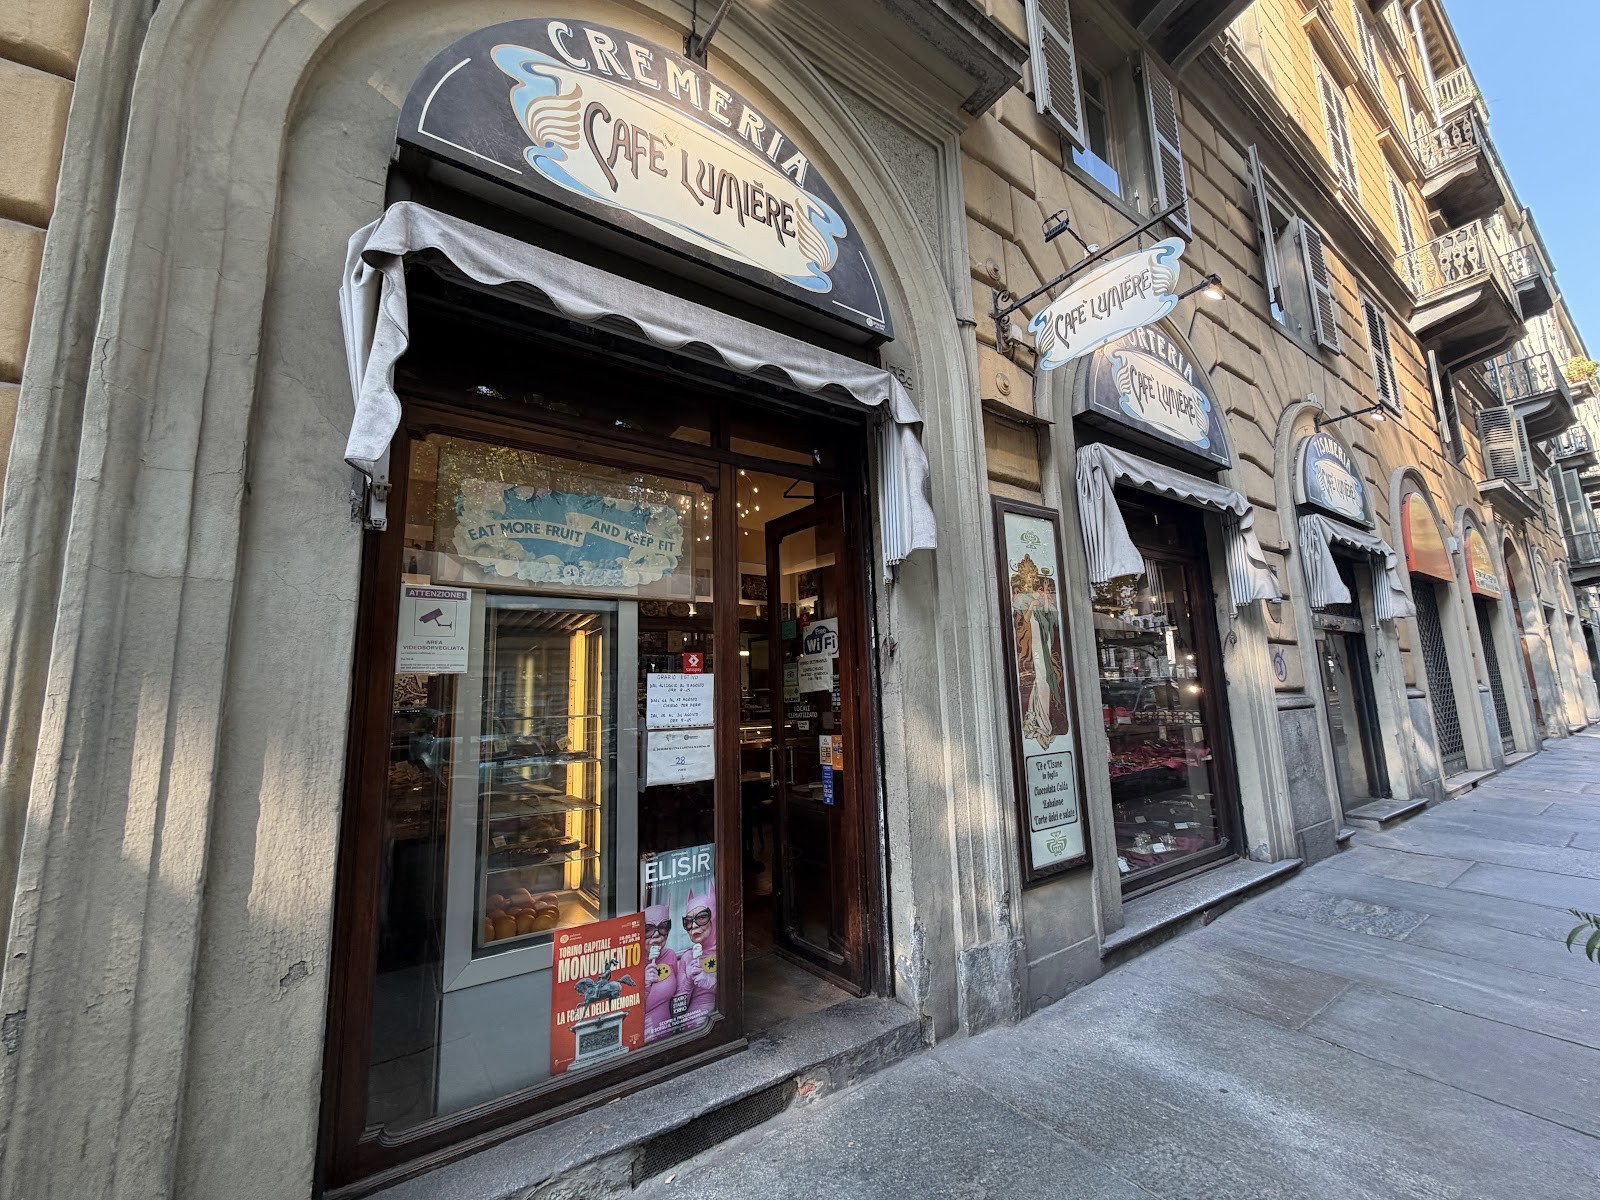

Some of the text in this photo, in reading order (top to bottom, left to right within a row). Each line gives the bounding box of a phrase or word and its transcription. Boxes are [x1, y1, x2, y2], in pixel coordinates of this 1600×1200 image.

[547, 20, 810, 190] CREMERIA
[1313, 437, 1351, 476] TISANERIA
[468, 521, 675, 552] EAT MORE FRUIT AND KEEP FIT
[409, 590, 465, 599] ATTENZIONE!
[676, 756, 686, 765] 28
[1047, 760, 1063, 769] Tisane
[1034, 781, 1068, 796] Cioccolata Calda
[1034, 815, 1048, 825] Torte
[645, 852, 711, 884] ELISIR
[559, 938, 611, 959] TORINO CAPITALE
[557, 943, 641, 983] MONUMENTO
[556, 1012, 566, 1025] LA
[591, 1001, 610, 1016] DELLA
[610, 992, 640, 1010] MEMORIA
